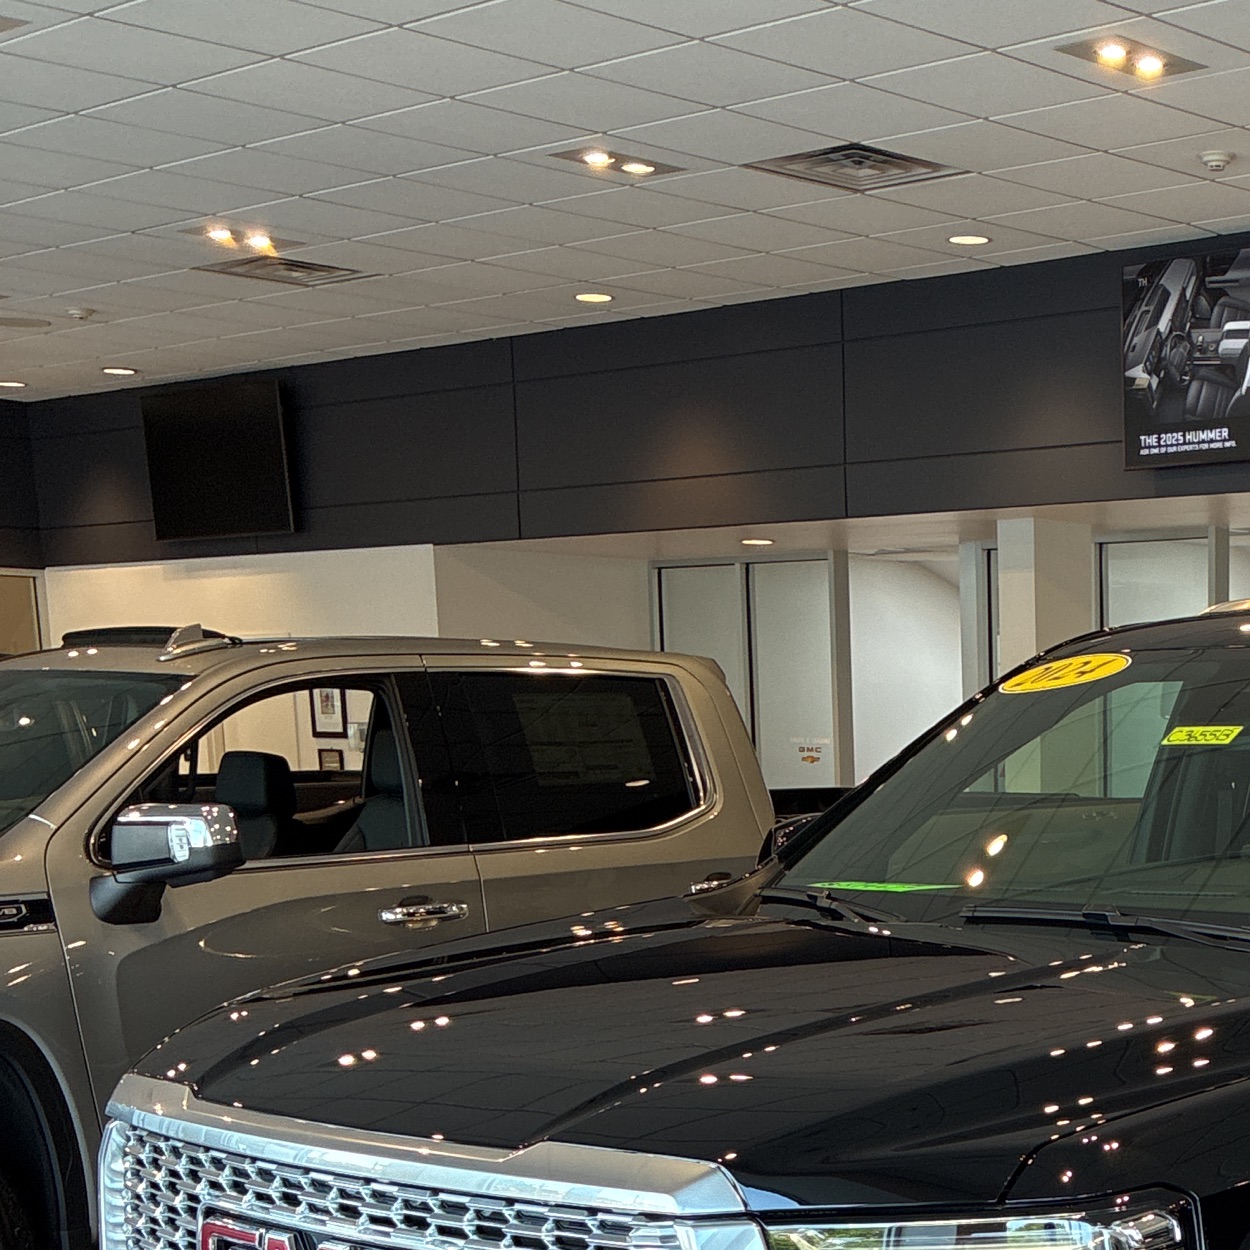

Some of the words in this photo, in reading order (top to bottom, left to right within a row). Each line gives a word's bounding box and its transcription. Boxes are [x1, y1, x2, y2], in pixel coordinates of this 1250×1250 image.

[1140, 434, 1159, 447] THE
[1160, 431, 1184, 445] 2025
[1185, 427, 1229, 443] HUMMER
[1178, 444, 1199, 452] EXPERTS
[1199, 443, 1209, 451] FOR
